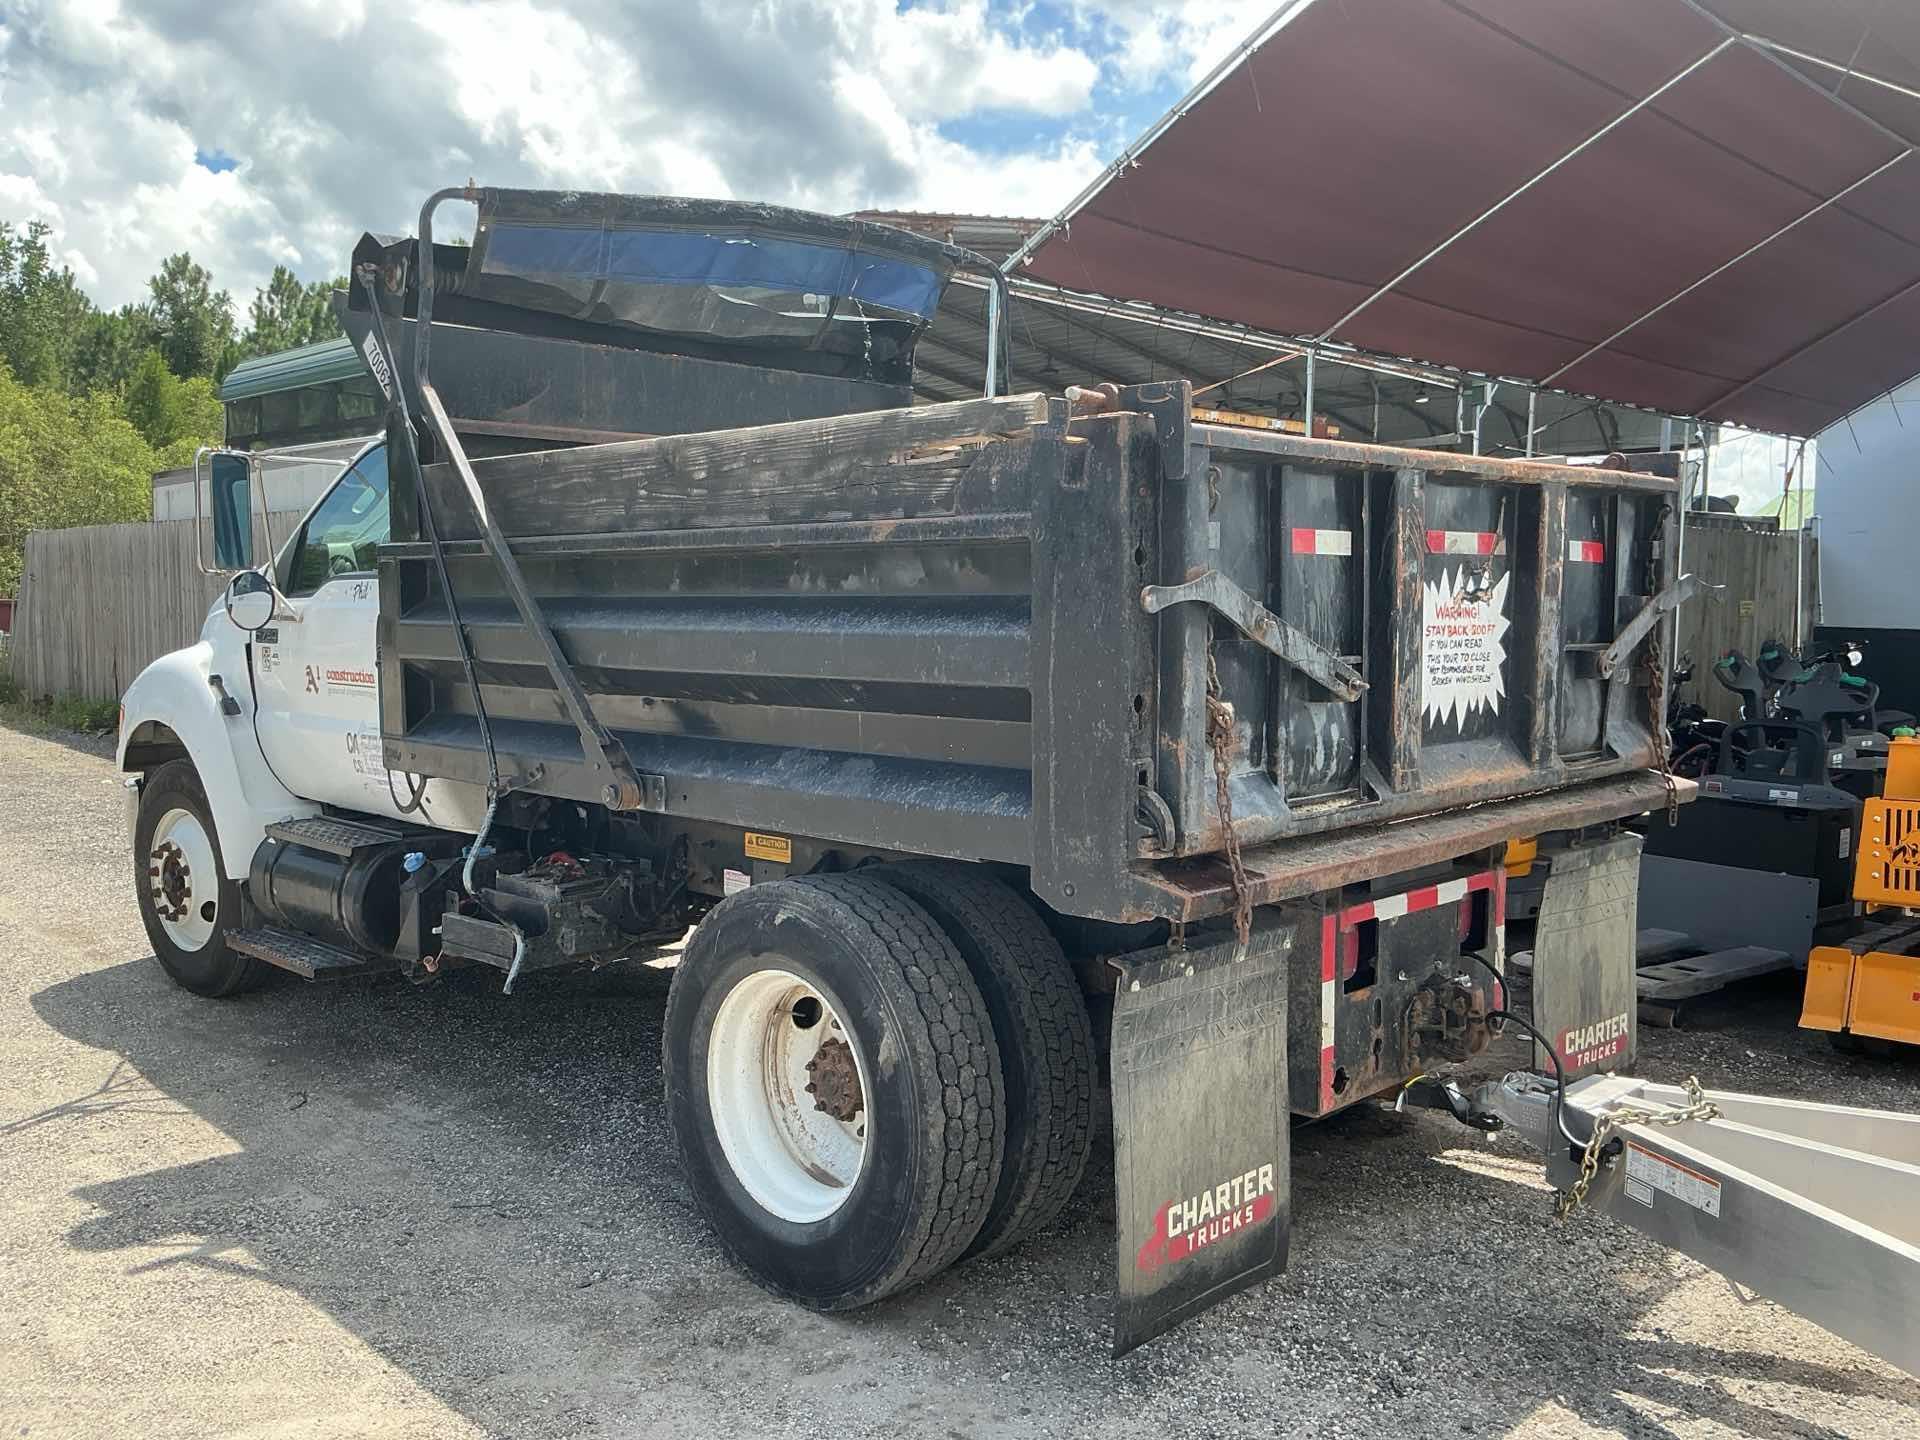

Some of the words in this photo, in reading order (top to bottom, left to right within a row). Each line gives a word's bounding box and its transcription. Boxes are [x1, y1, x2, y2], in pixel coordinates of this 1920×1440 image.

[1425, 625, 1446, 637] STAY
[1447, 624, 1469, 637] BACK
[1429, 639, 1435, 649] IF
[1436, 639, 1448, 649] YOU
[1449, 639, 1463, 649] CAN
[1464, 638, 1483, 649] READ
[1427, 654, 1441, 664] THIS
[1442, 653, 1459, 664] YOUR
[1460, 653, 1470, 662] TO
[1470, 651, 1491, 662] CLOSE
[326, 667, 375, 684] construction
[757, 837, 787, 850] CAUTION
[1565, 1012, 1629, 1055] CHARTER
[1576, 1041, 1617, 1067] TRUCKS
[1166, 1163, 1274, 1239] CHARTER
[1187, 1204, 1254, 1252] TRUCKS
